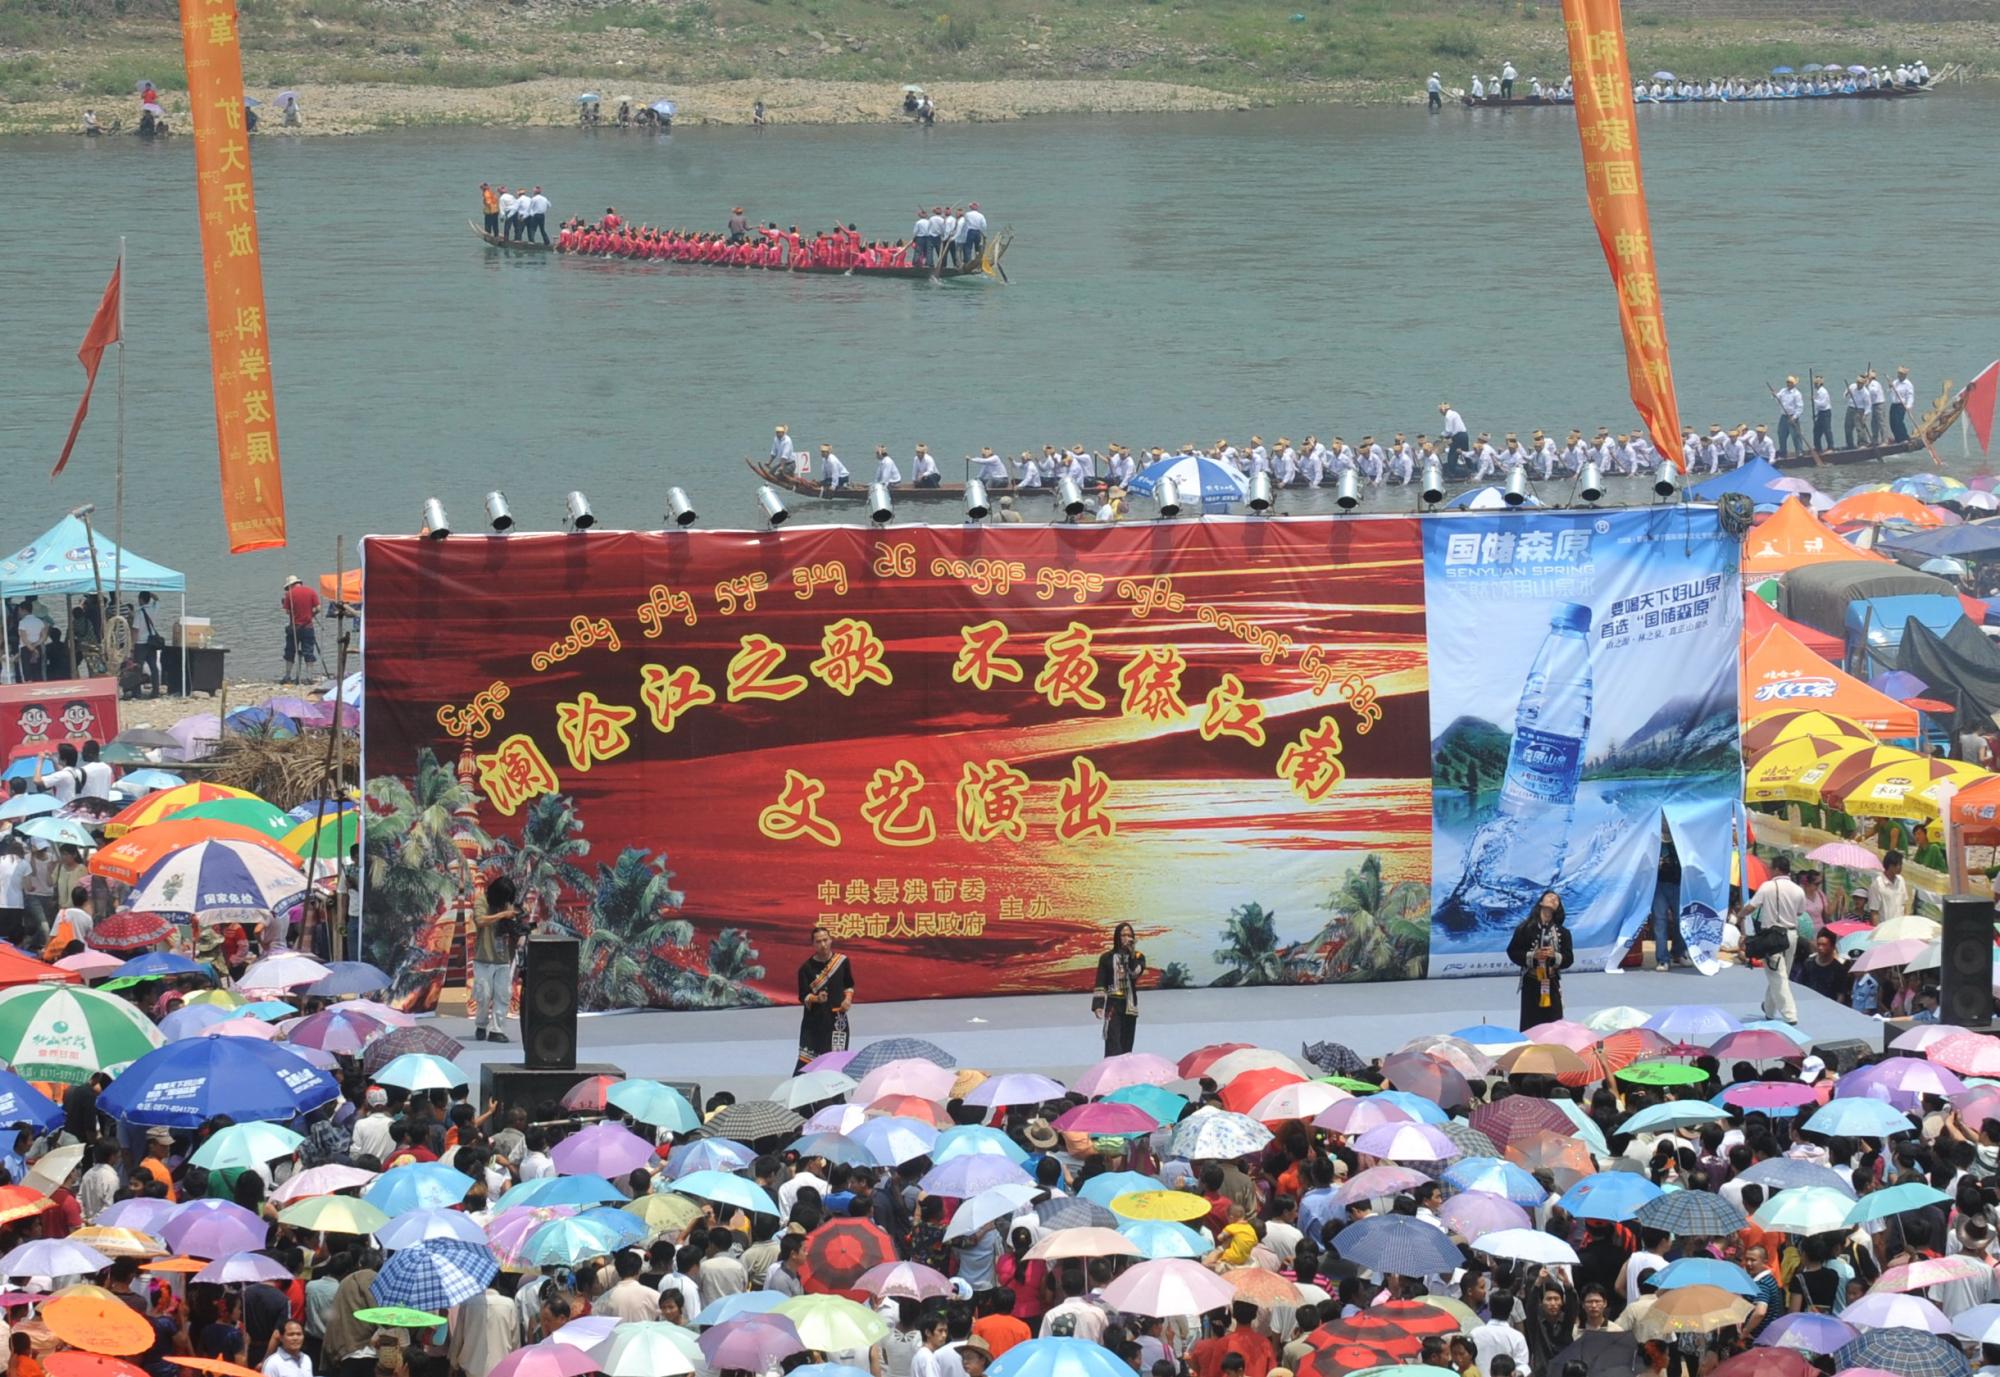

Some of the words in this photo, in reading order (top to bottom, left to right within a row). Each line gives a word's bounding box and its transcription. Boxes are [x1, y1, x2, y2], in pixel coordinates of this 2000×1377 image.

[1445, 529, 1593, 566] 国储森原
[1446, 567, 1527, 578] SENYUAN
[1532, 564, 1595, 577] SPRING
[1611, 574, 1721, 618] 要喝天下好山泉
[1601, 618, 1629, 639] 首选
[476, 618, 893, 816] 澜沧江之歌
[953, 620, 1345, 805] 不夜傣江南
[759, 755, 1117, 847] 文艺演出
[818, 878, 986, 904] 中共景洪市委
[1000, 894, 1053, 920] 主办
[816, 911, 986, 938] 景洪市人民政府
